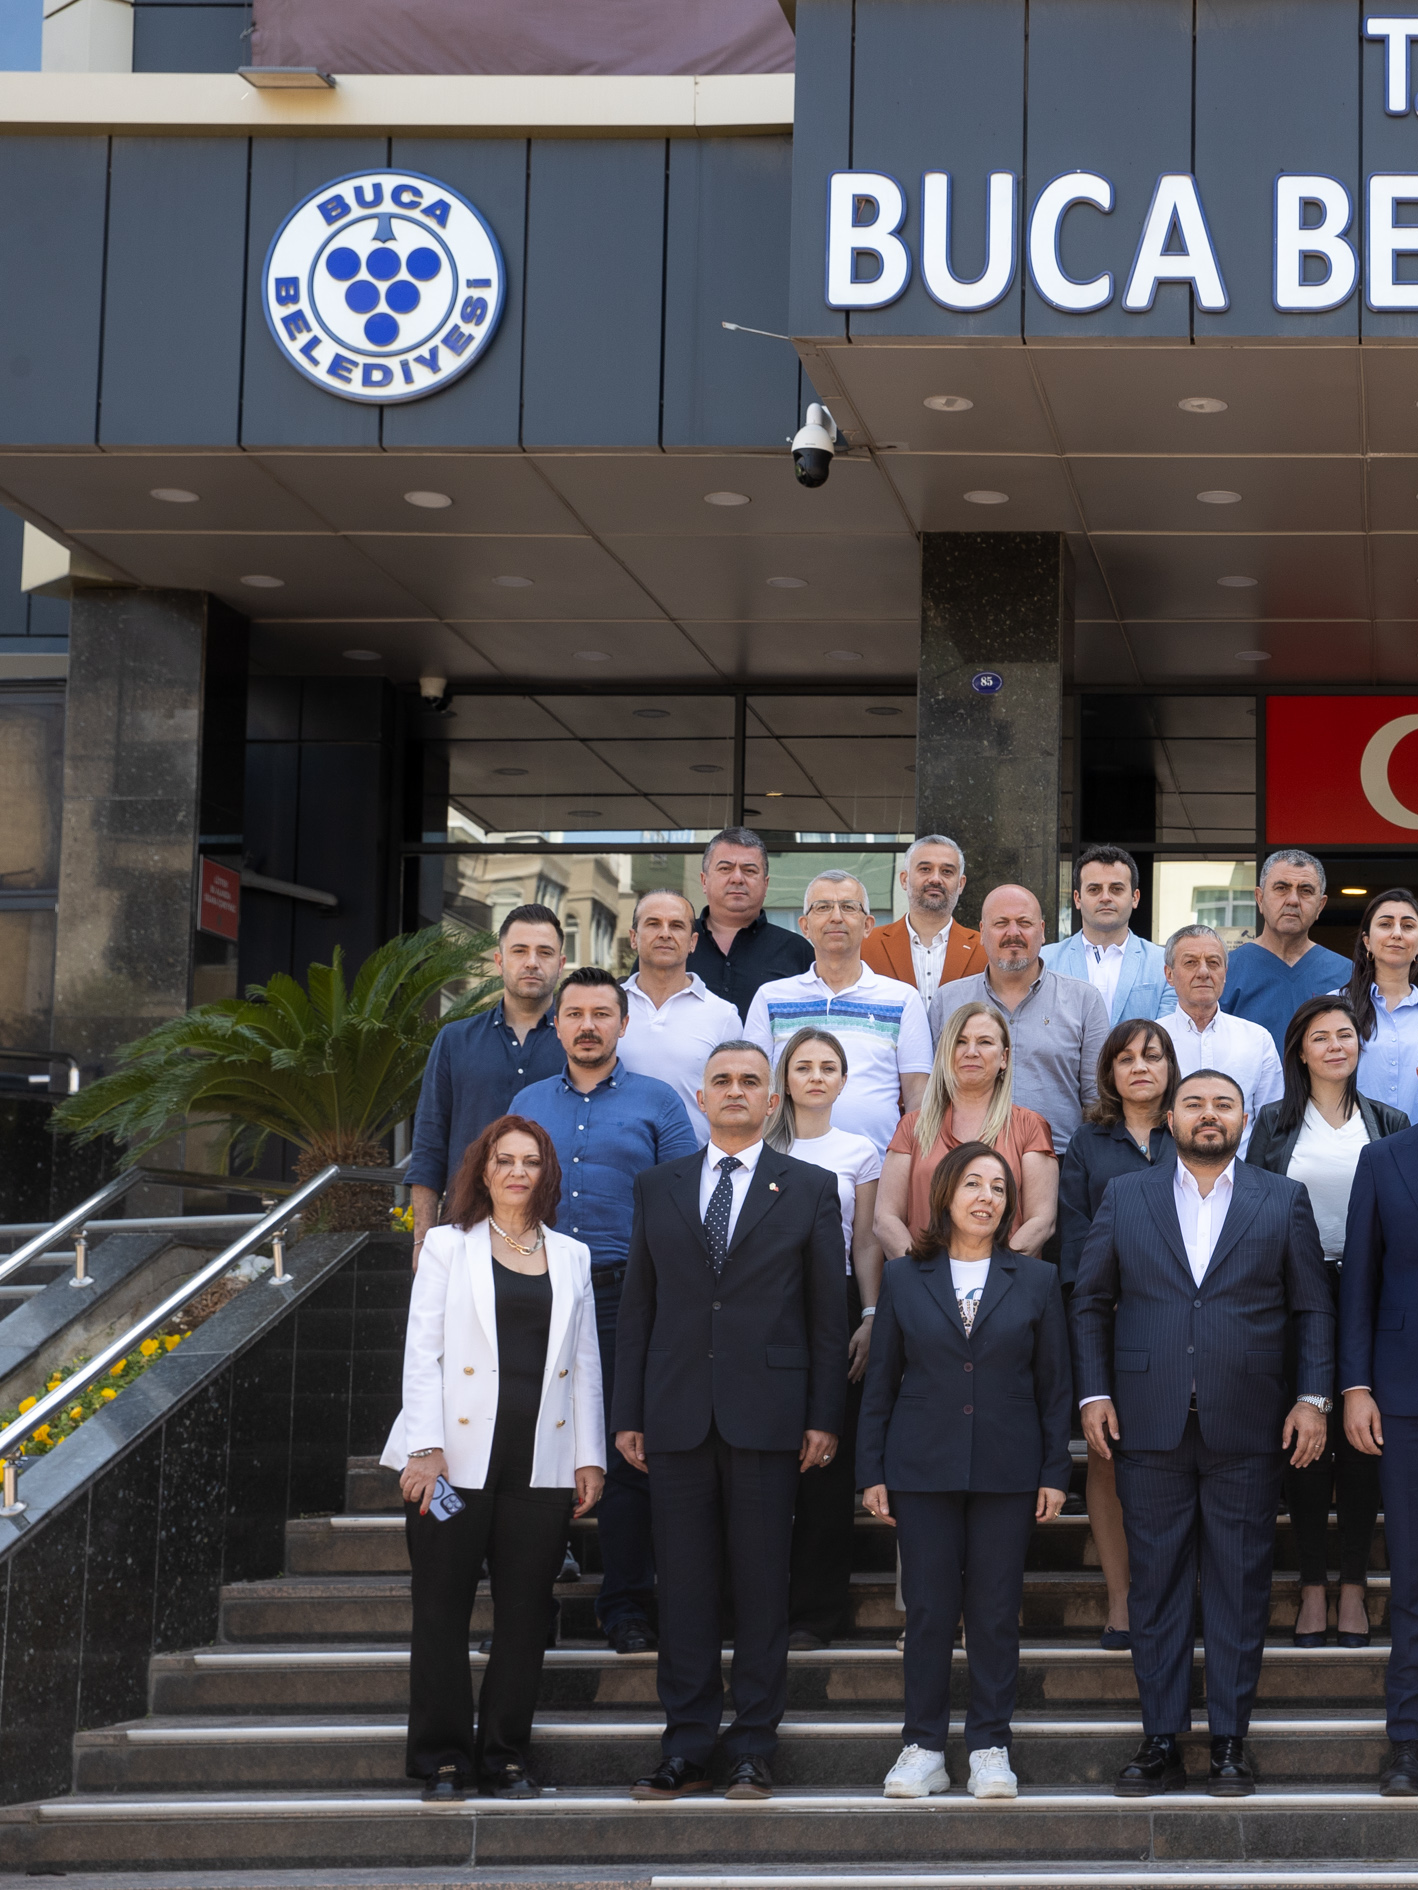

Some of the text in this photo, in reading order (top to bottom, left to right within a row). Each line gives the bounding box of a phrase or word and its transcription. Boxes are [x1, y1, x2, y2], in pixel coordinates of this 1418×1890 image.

[317, 182, 452, 230] BUCA
[825, 169, 1231, 313] BUCA
[275, 276, 492, 388] BELEDİYESİ
[980, 676, 993, 687] 85
